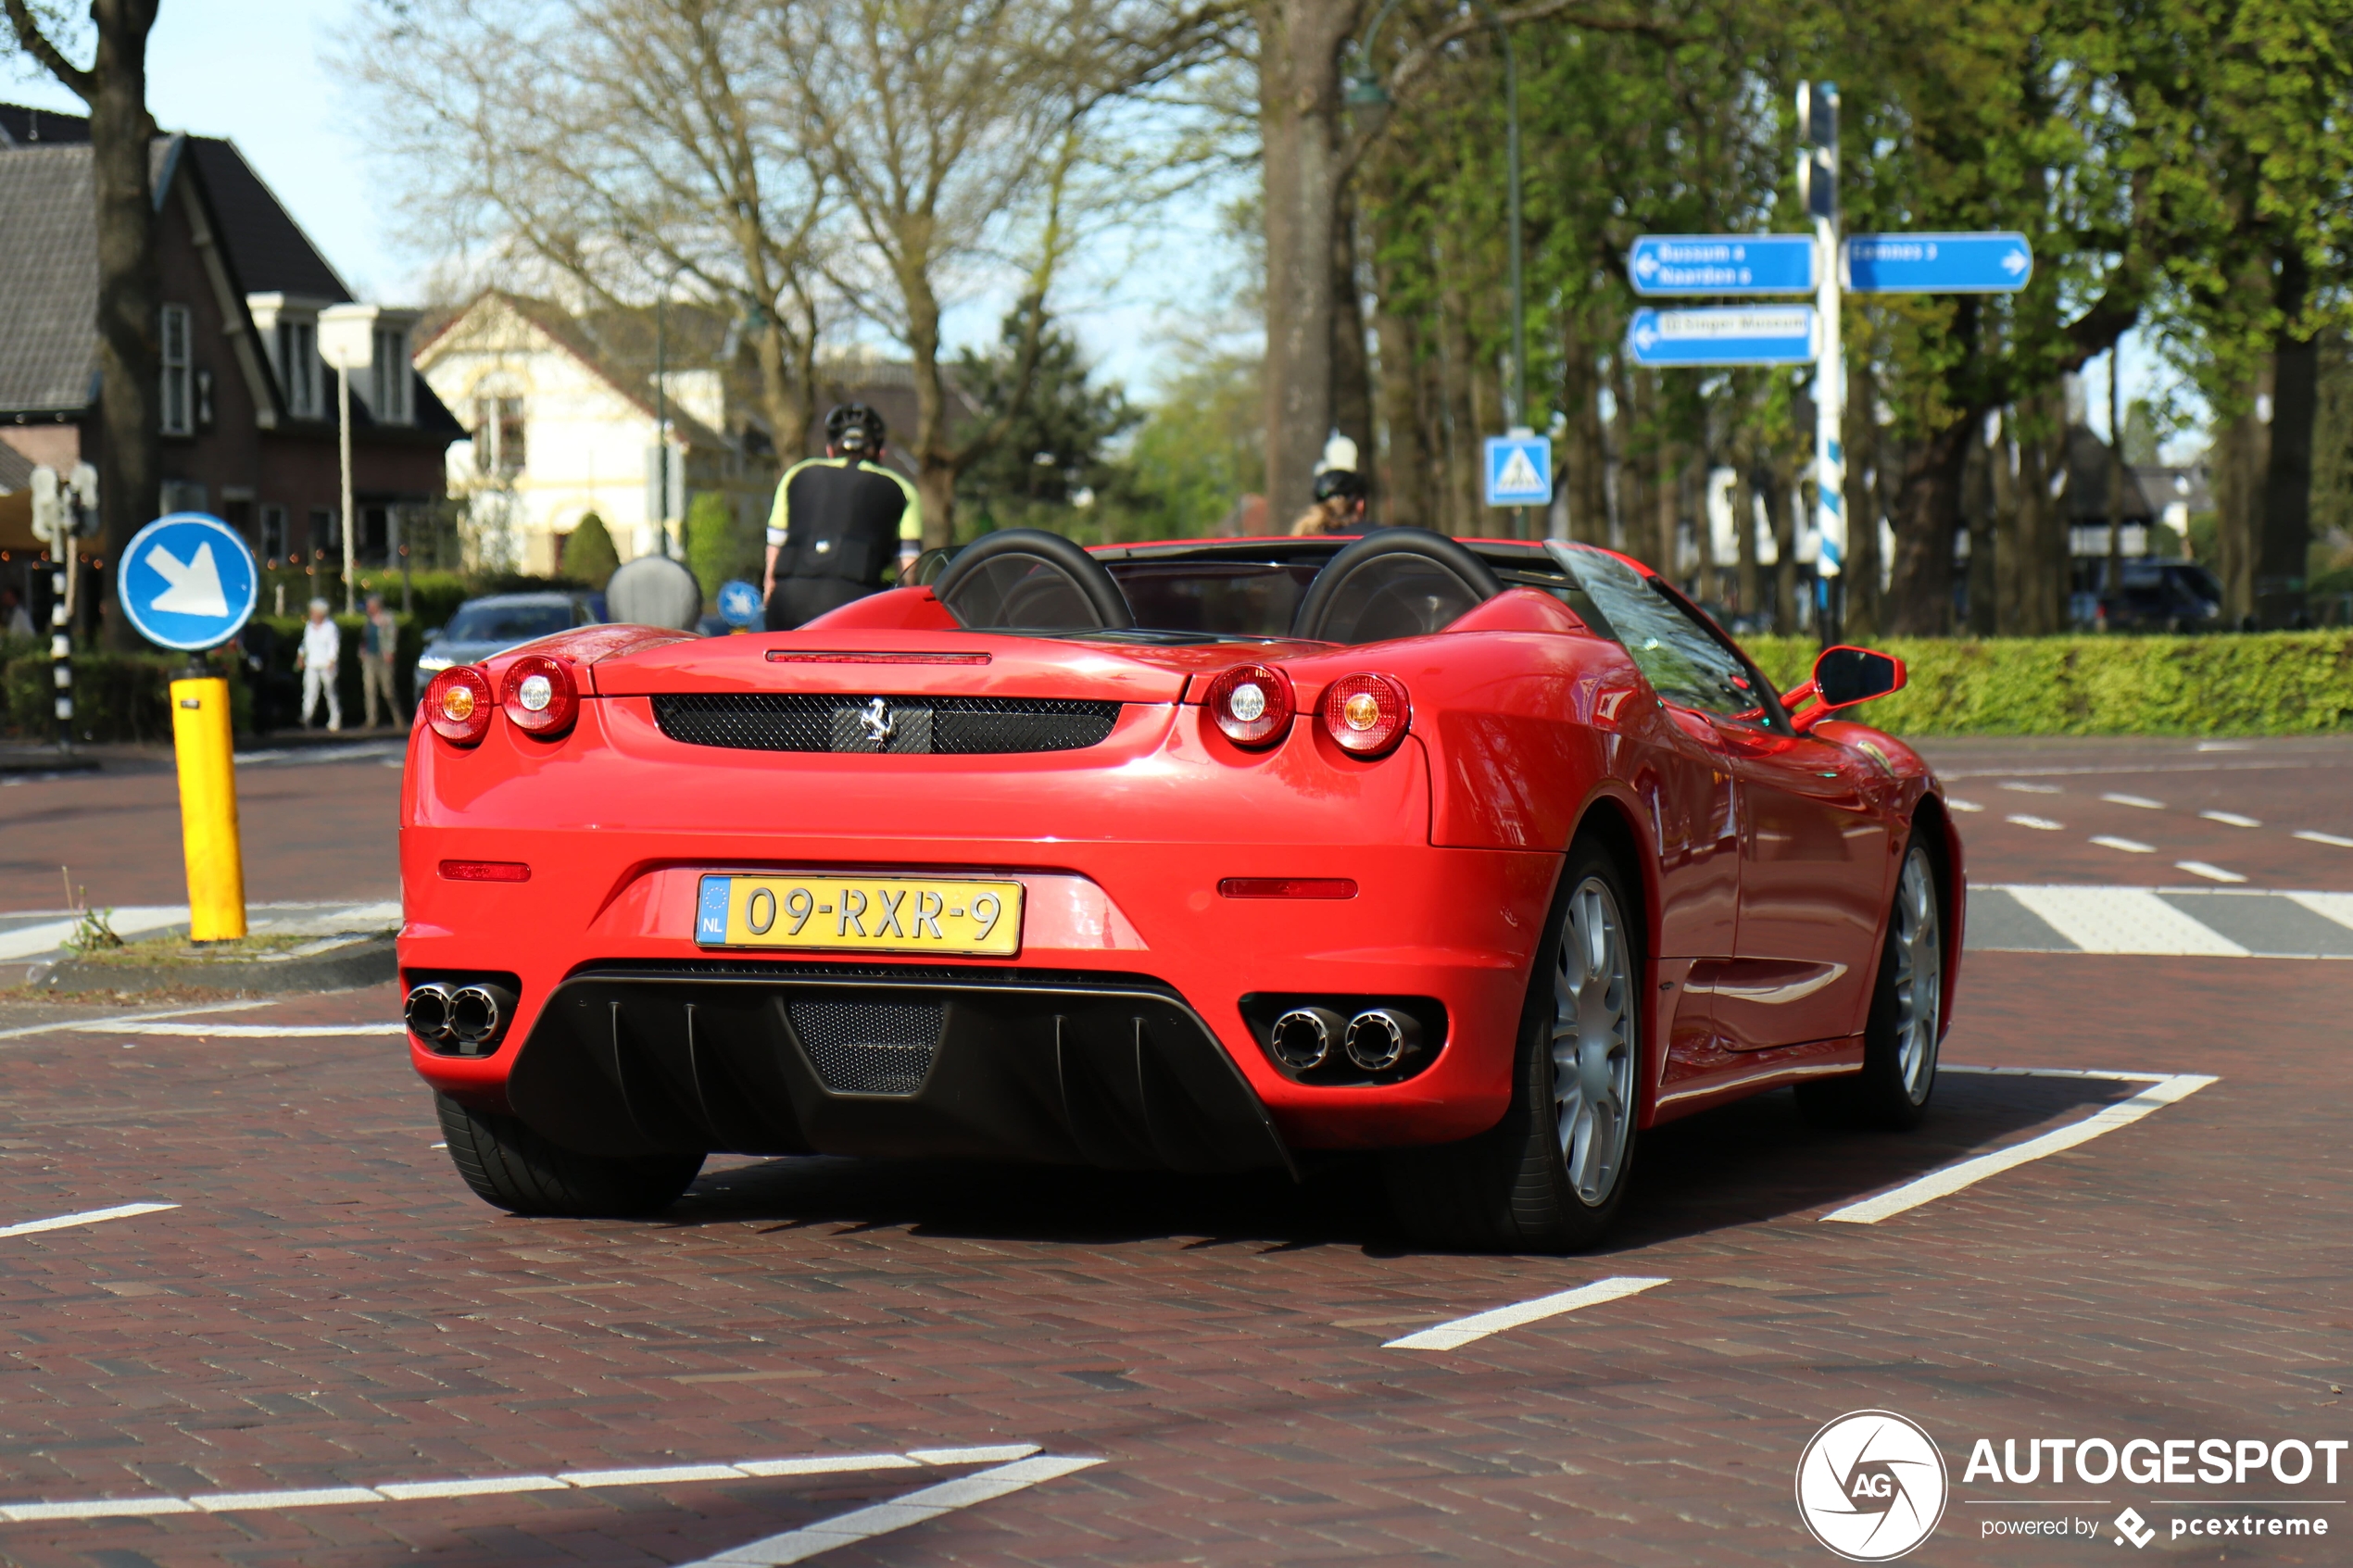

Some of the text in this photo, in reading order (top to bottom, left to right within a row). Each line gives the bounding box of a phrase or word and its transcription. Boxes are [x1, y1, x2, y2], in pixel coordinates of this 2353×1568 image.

[1658, 266, 1736, 285] Naarden
[744, 886, 1001, 941] 09-RXR-9
[702, 918, 723, 934] NL
